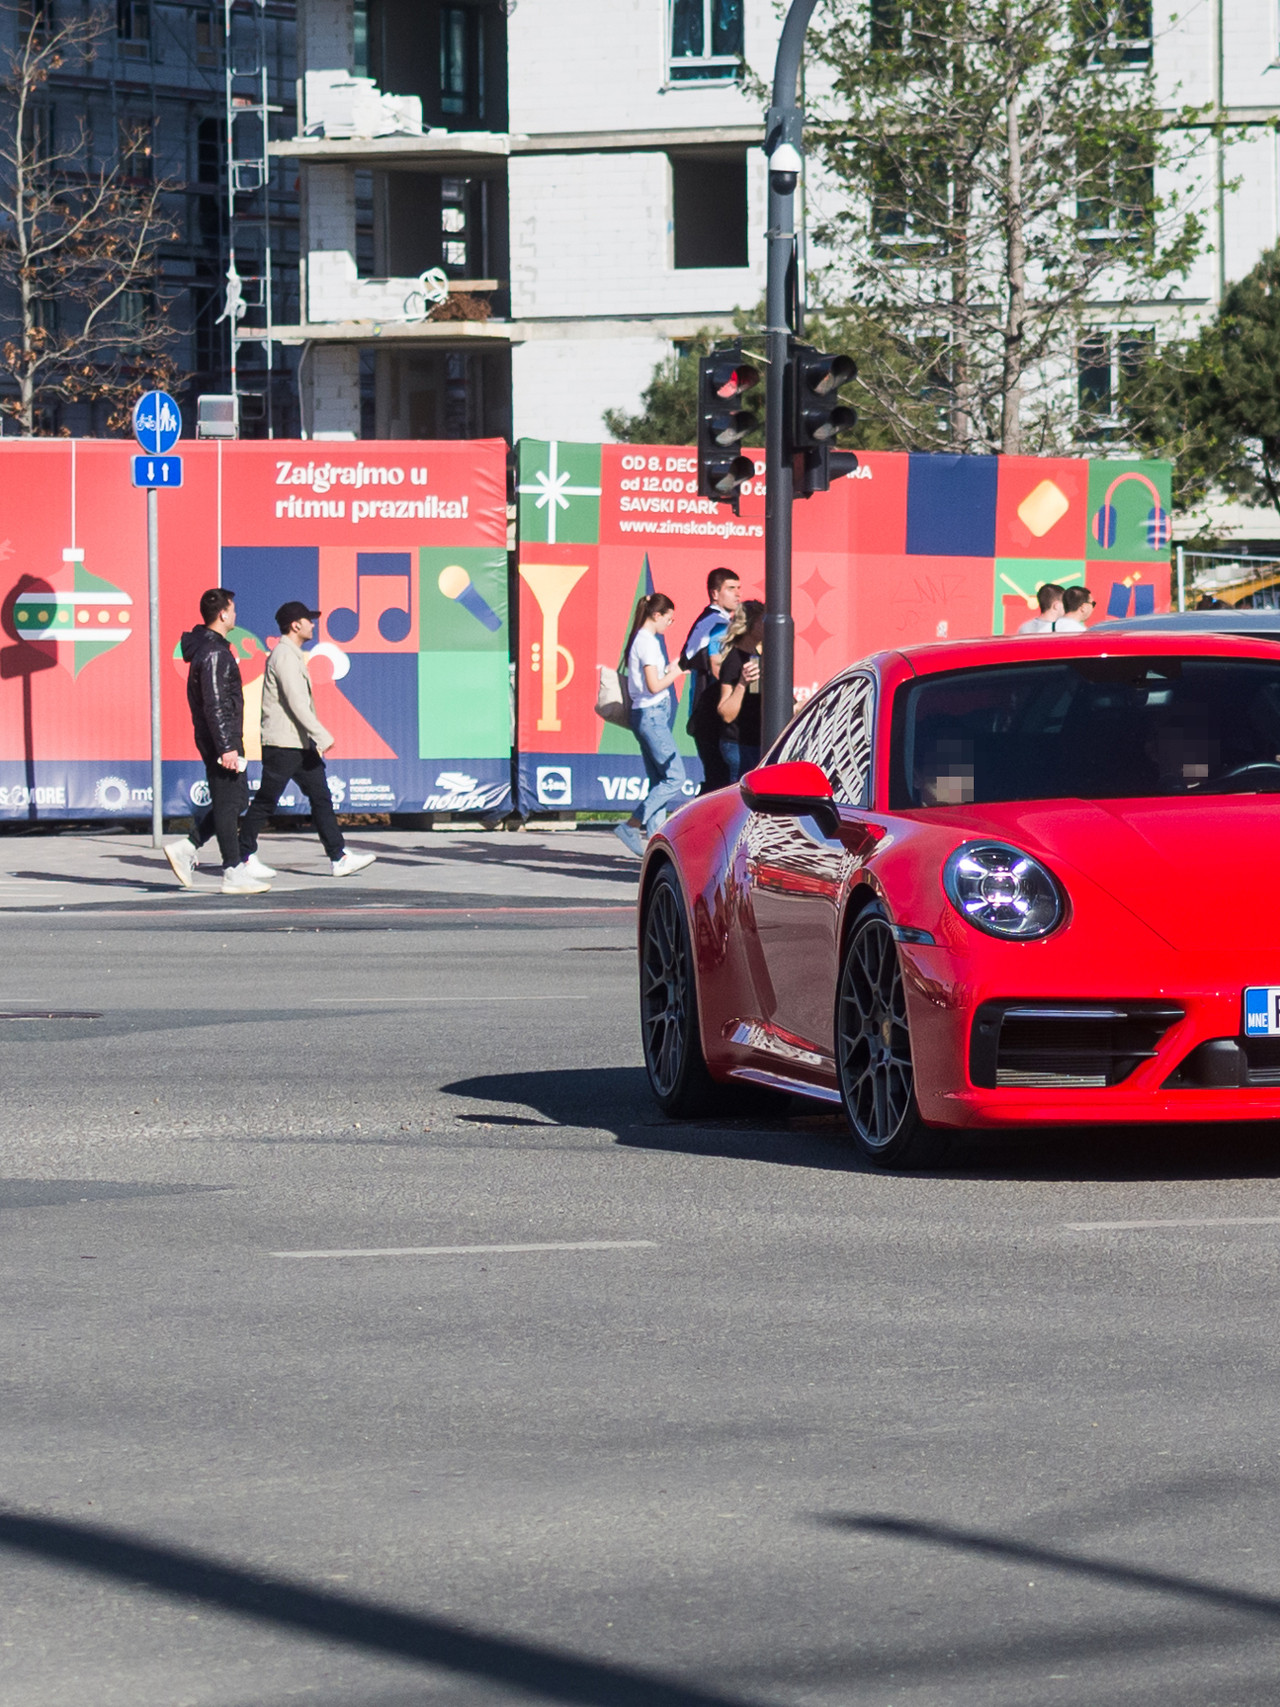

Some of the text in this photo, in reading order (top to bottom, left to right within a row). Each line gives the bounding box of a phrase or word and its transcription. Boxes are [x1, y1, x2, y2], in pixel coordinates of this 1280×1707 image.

[621, 455, 646, 471] OD
[648, 457, 663, 472] 8.
[665, 457, 698, 473] DEC
[275, 461, 428, 493] Zaigrajmo u
[620, 477, 640, 492] od
[642, 477, 684, 493] 12.00
[275, 494, 469, 524] ritmu praznika!
[619, 496, 719, 516] SAVSKI PARK
[619, 519, 764, 540] www.zimskabajka.rs
[131, 786, 153, 801] mt
[1247, 1012, 1268, 1028] MNE
